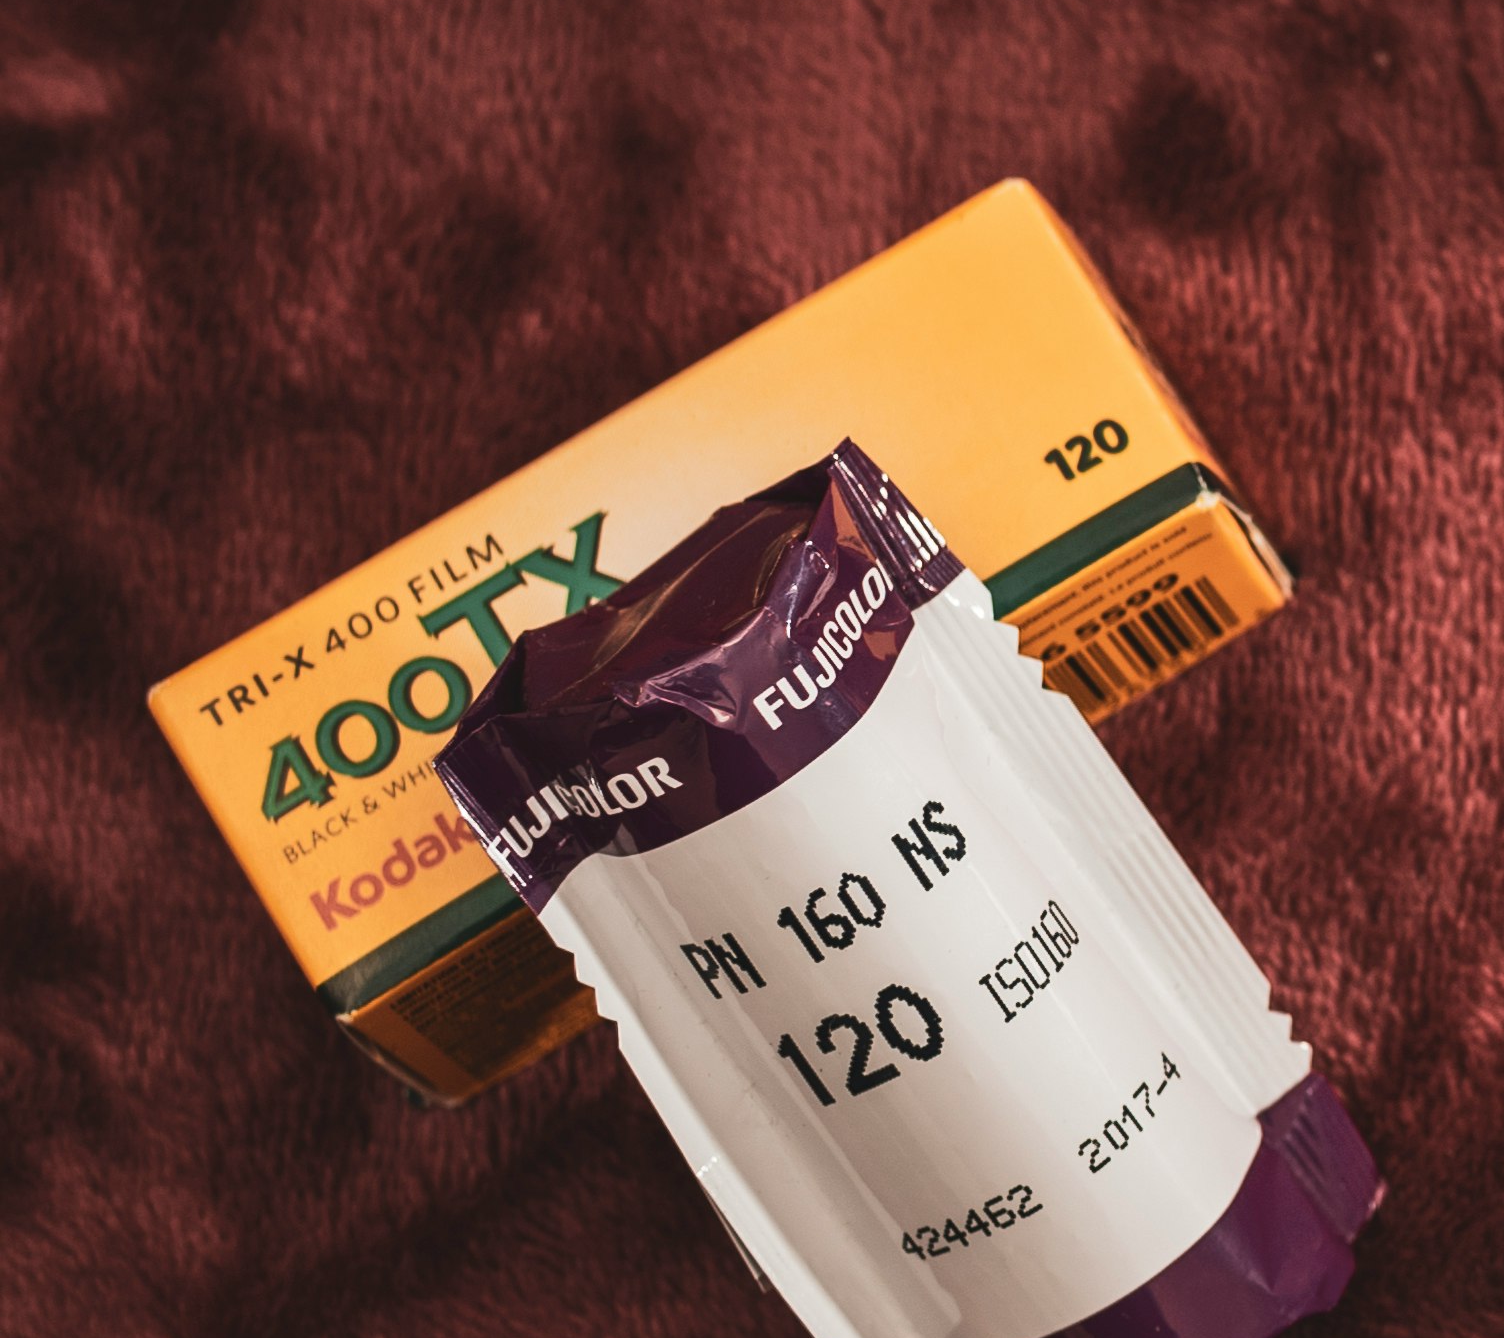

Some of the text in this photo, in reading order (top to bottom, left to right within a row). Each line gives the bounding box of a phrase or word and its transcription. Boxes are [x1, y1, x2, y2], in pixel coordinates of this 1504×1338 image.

[1043, 418, 1130, 482] 120
[199, 533, 506, 728] TRI-X 400 FILM
[260, 508, 628, 826] 400TX
[281, 806, 360, 865] BLACK
[362, 795, 381, 816] &
[309, 812, 478, 933] Kodak
[484, 755, 684, 883] FUJICOLOR
[680, 800, 967, 1000] PN 160 NS
[777, 899, 1080, 1108] 120 ISO160
[901, 1051, 1181, 1261] 424462 2017-4
